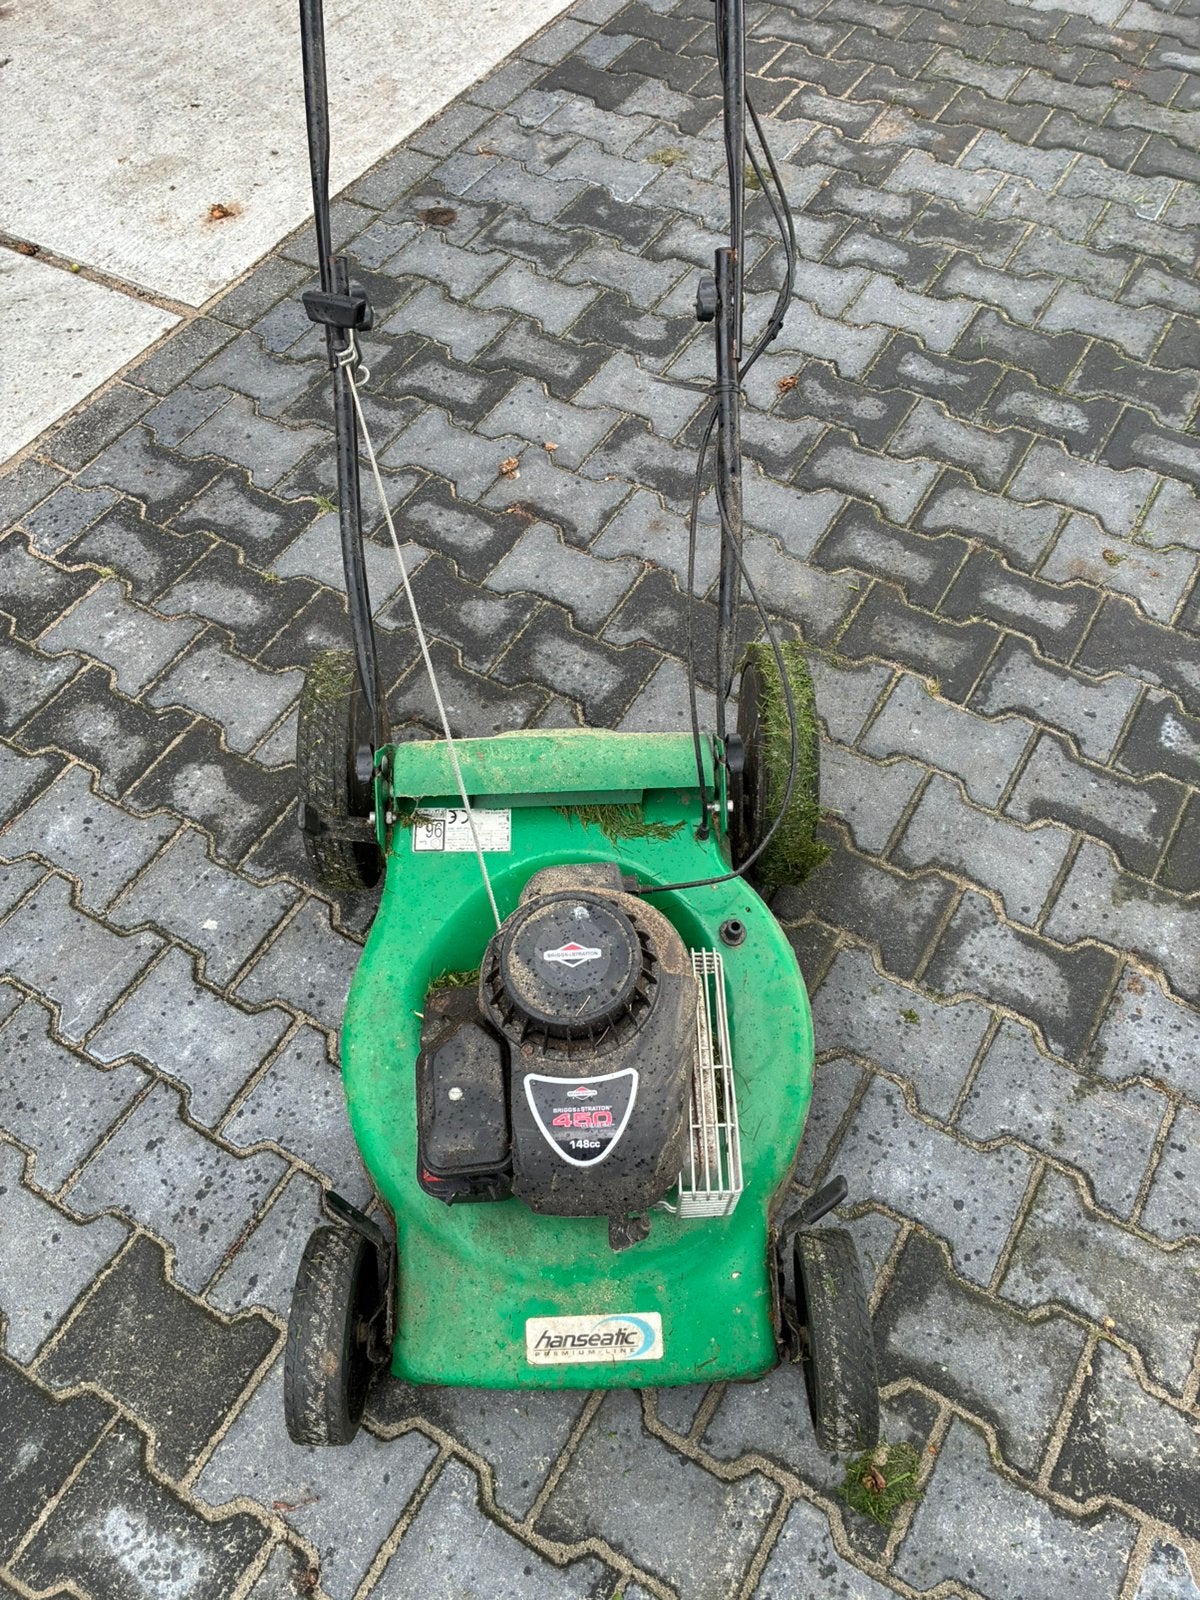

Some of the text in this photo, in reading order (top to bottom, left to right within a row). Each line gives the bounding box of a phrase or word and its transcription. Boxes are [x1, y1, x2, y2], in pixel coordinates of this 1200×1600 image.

[552, 1111, 613, 1128] 450
[569, 1139, 601, 1150] 148cc
[534, 1327, 638, 1349] hanseatic
